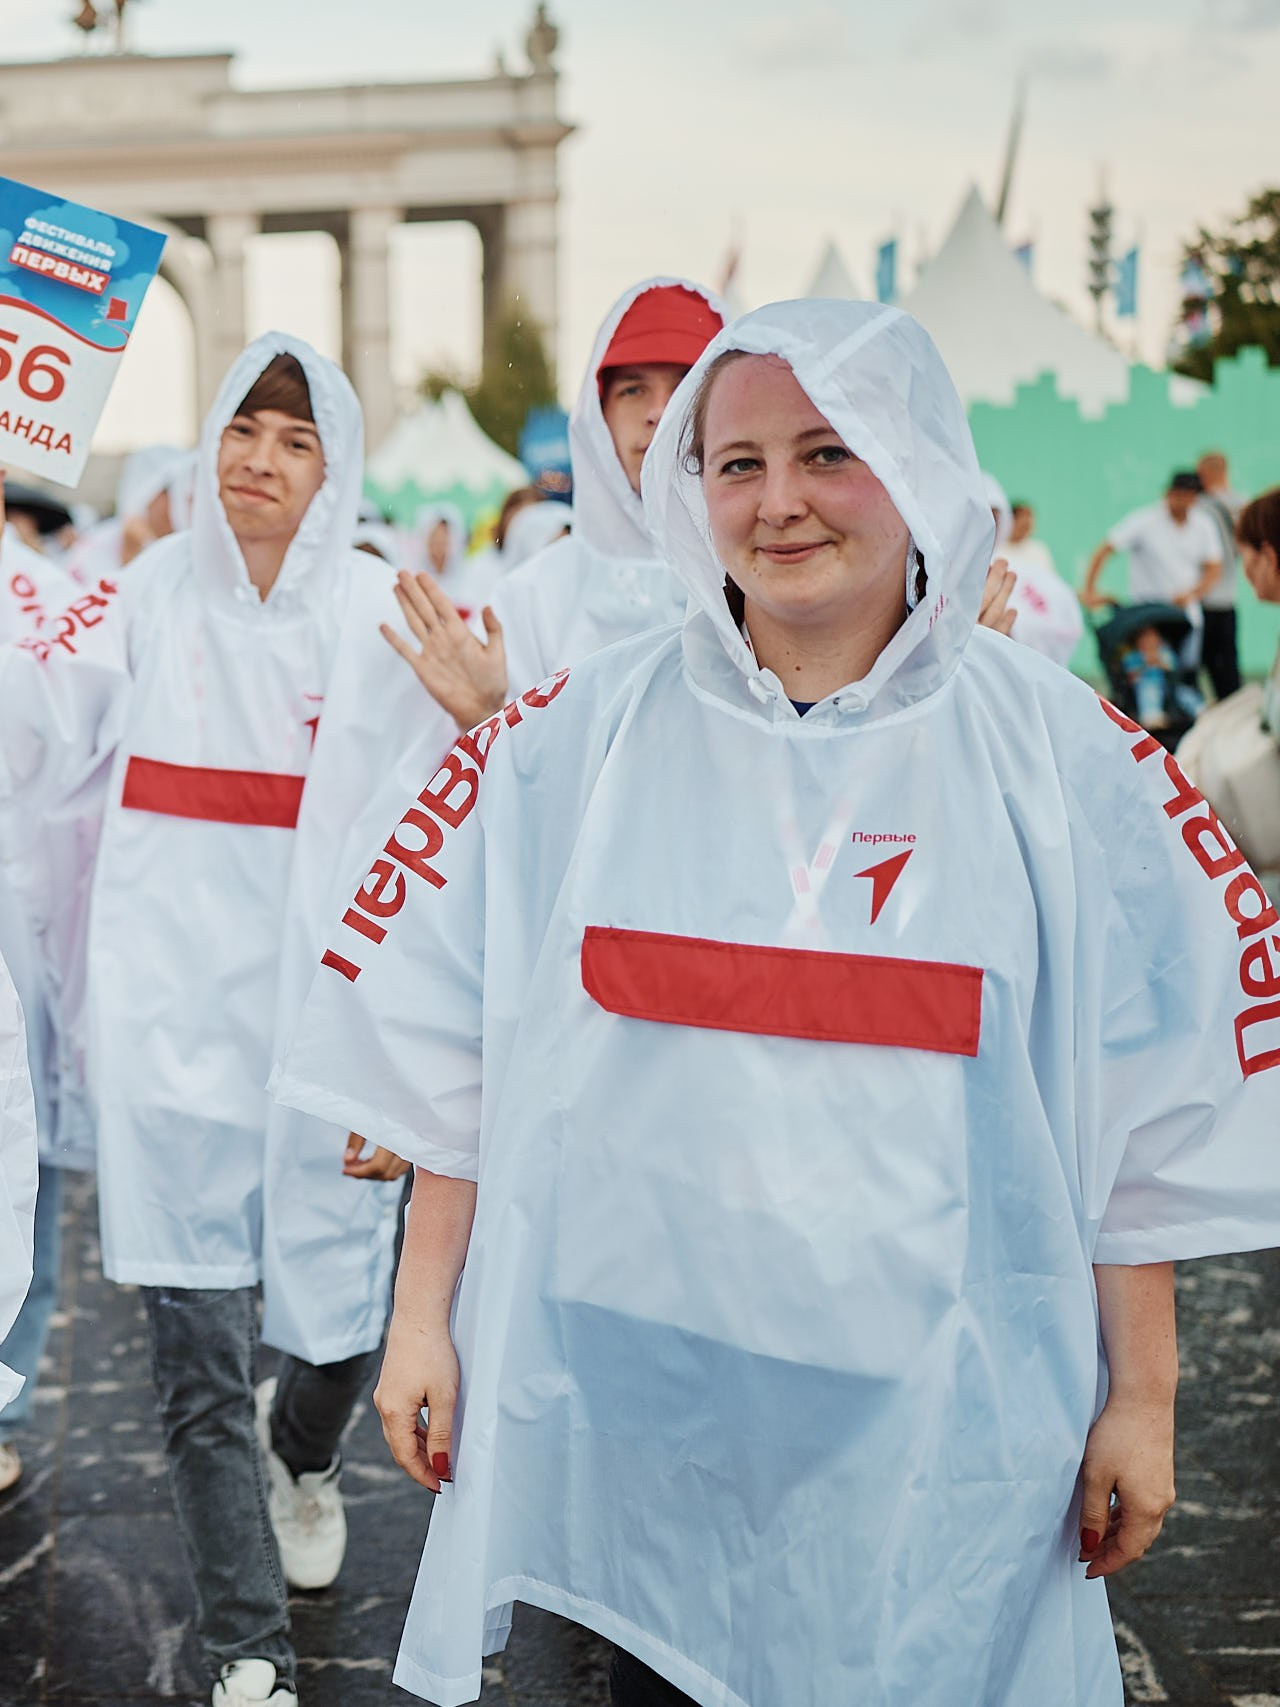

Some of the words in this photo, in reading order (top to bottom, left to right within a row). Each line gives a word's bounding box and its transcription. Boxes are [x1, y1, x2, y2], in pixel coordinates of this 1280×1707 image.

[17, 230, 112, 272] ДВИЖЕНИЯ
[24, 216, 116, 257] ФЕСТИВАЛЬ
[11, 246, 106, 292] ПЕРВЫХ
[851, 831, 917, 845] Первые
